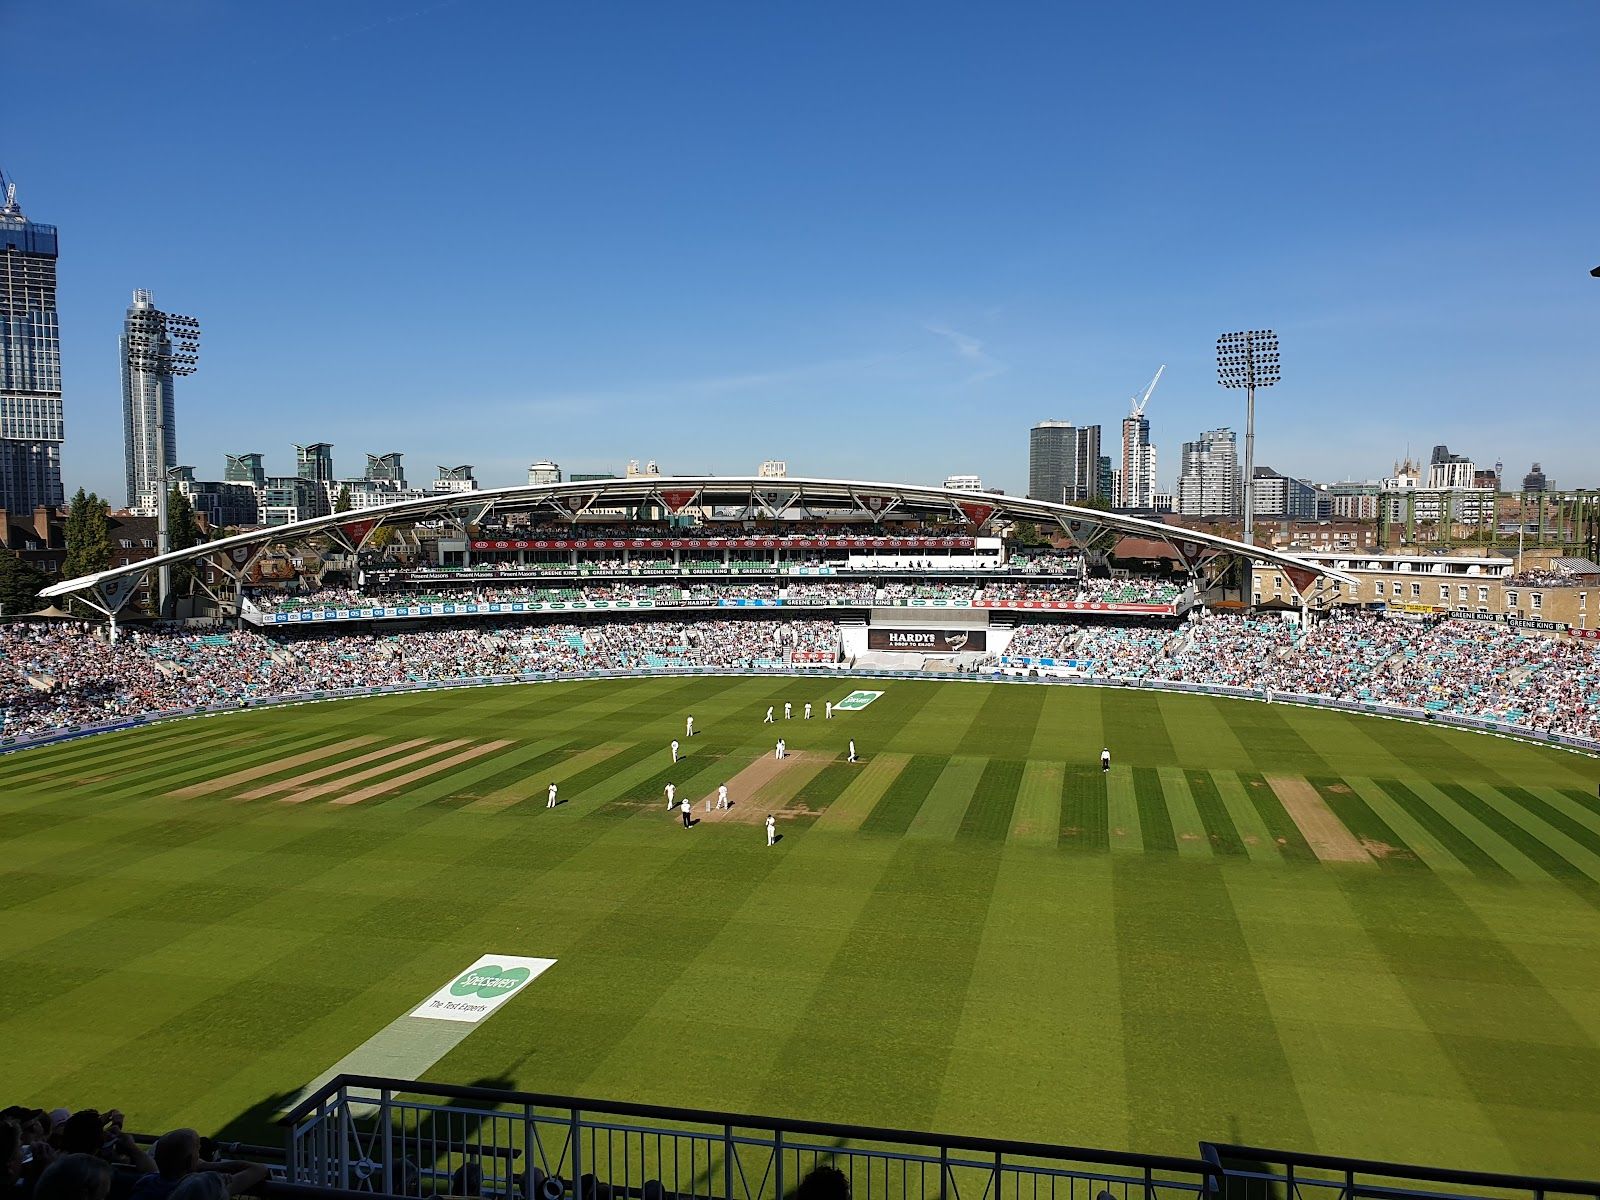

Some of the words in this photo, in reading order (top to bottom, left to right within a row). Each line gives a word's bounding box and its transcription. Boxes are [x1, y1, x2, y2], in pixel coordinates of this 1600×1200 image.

[889, 633, 935, 642] HARDYS
[28, 730, 55, 739] Specsavers
[1510, 728, 1535, 737] Specsavers
[461, 973, 518, 989] Specsavers
[429, 1000, 443, 1009] The
[444, 1001, 459, 1010] Test
[459, 1003, 487, 1013] Experts
